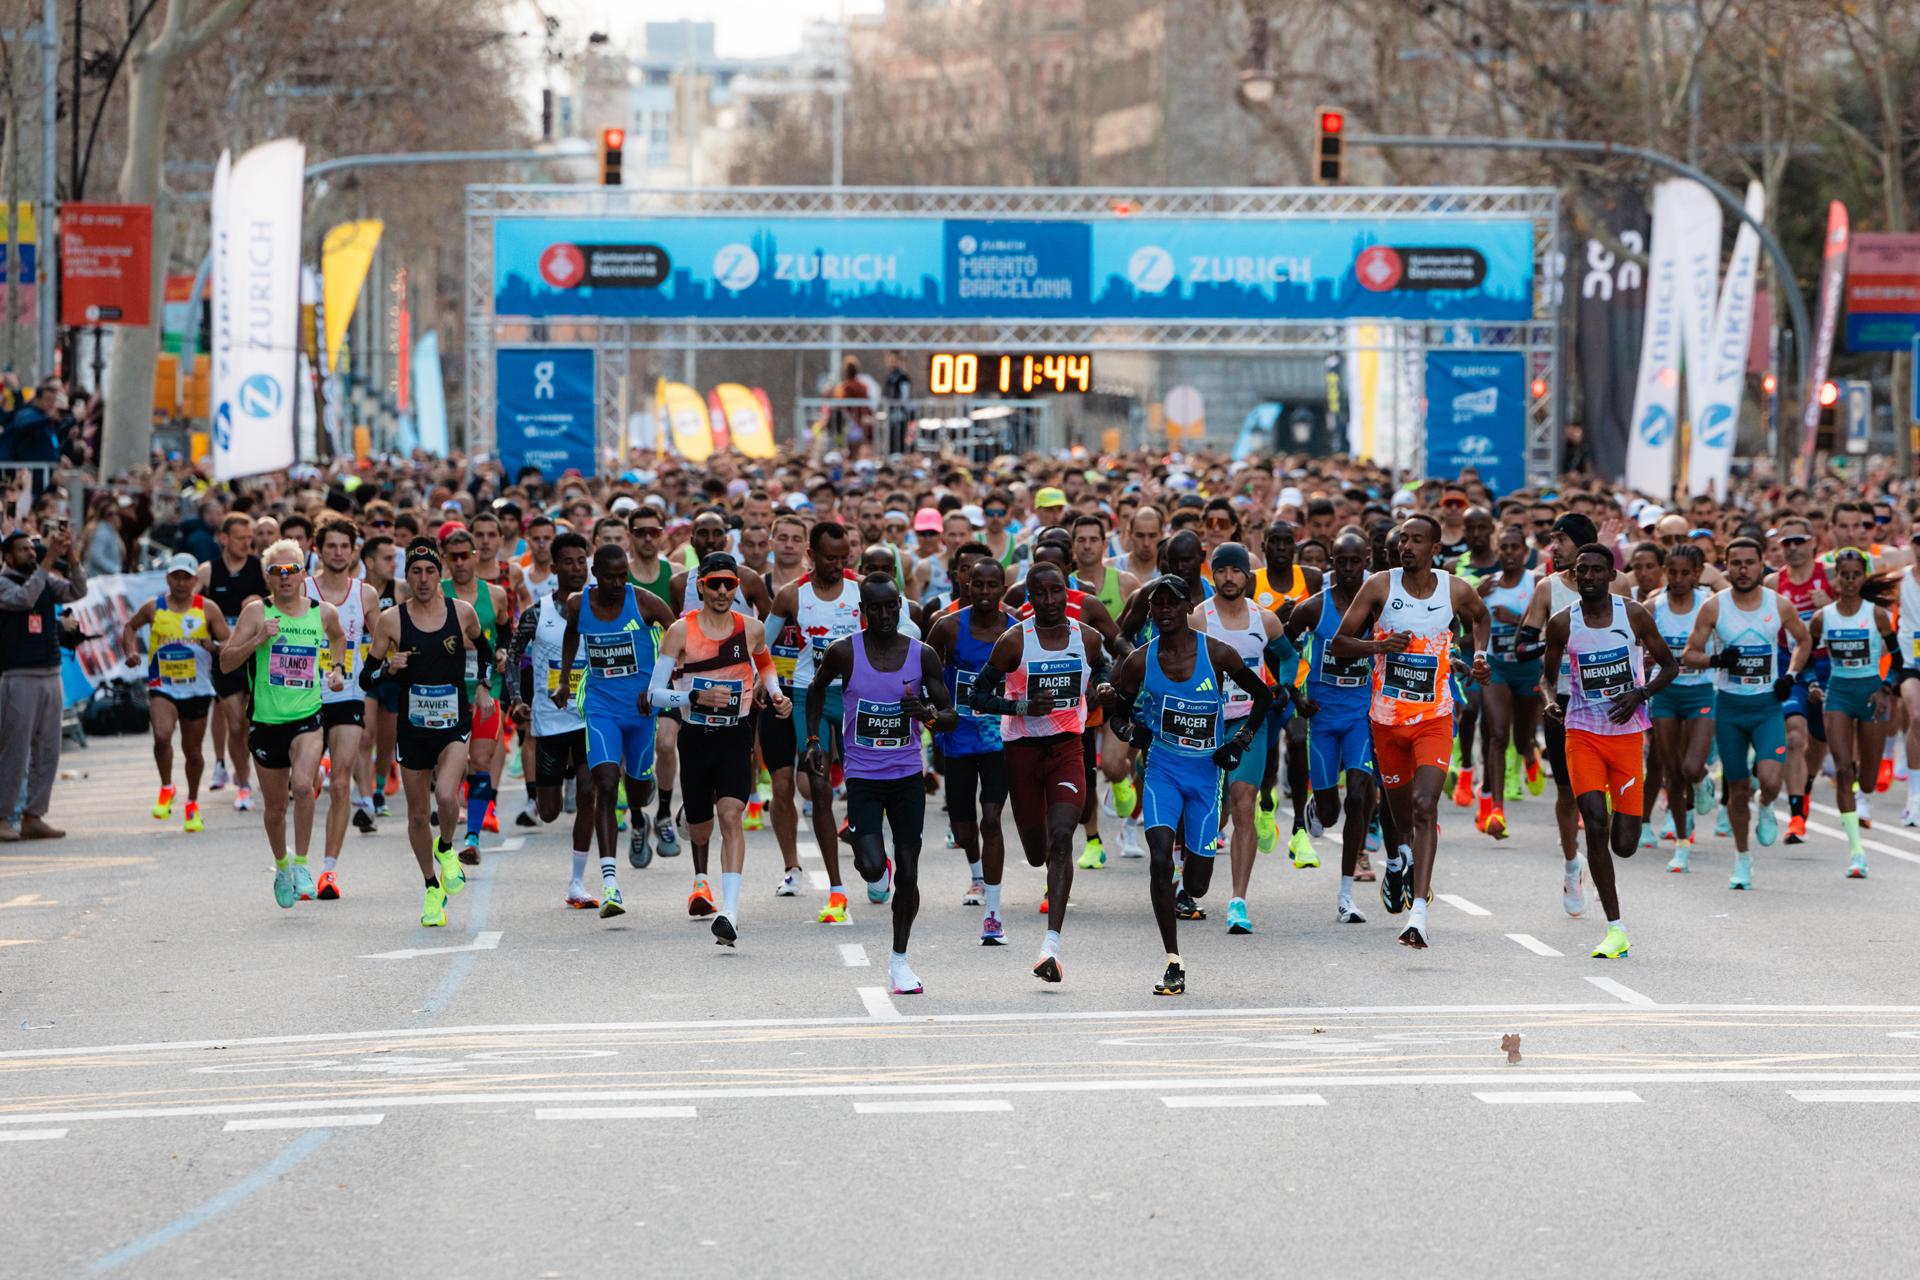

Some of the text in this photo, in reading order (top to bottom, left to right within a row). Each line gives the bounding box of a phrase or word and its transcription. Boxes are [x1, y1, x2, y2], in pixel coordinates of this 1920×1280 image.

[774, 255, 897, 280] ZURICH
[1189, 256, 1312, 282] ZURICH
[959, 278, 1072, 298] BARCELONA
[930, 354, 1090, 394] 00 11:44
[589, 645, 633, 659] BENJAMIN
[279, 656, 308, 670] BLANCO
[1407, 656, 1427, 664] ZURICH
[1394, 666, 1428, 682] NIGUSU
[1583, 661, 1628, 679] MEKUANT
[1039, 677, 1071, 688] PACER
[1605, 677, 1610, 685] 2
[417, 700, 449, 710] XAVIER
[868, 717, 901, 728] PACER
[1173, 715, 1207, 728] PACER
